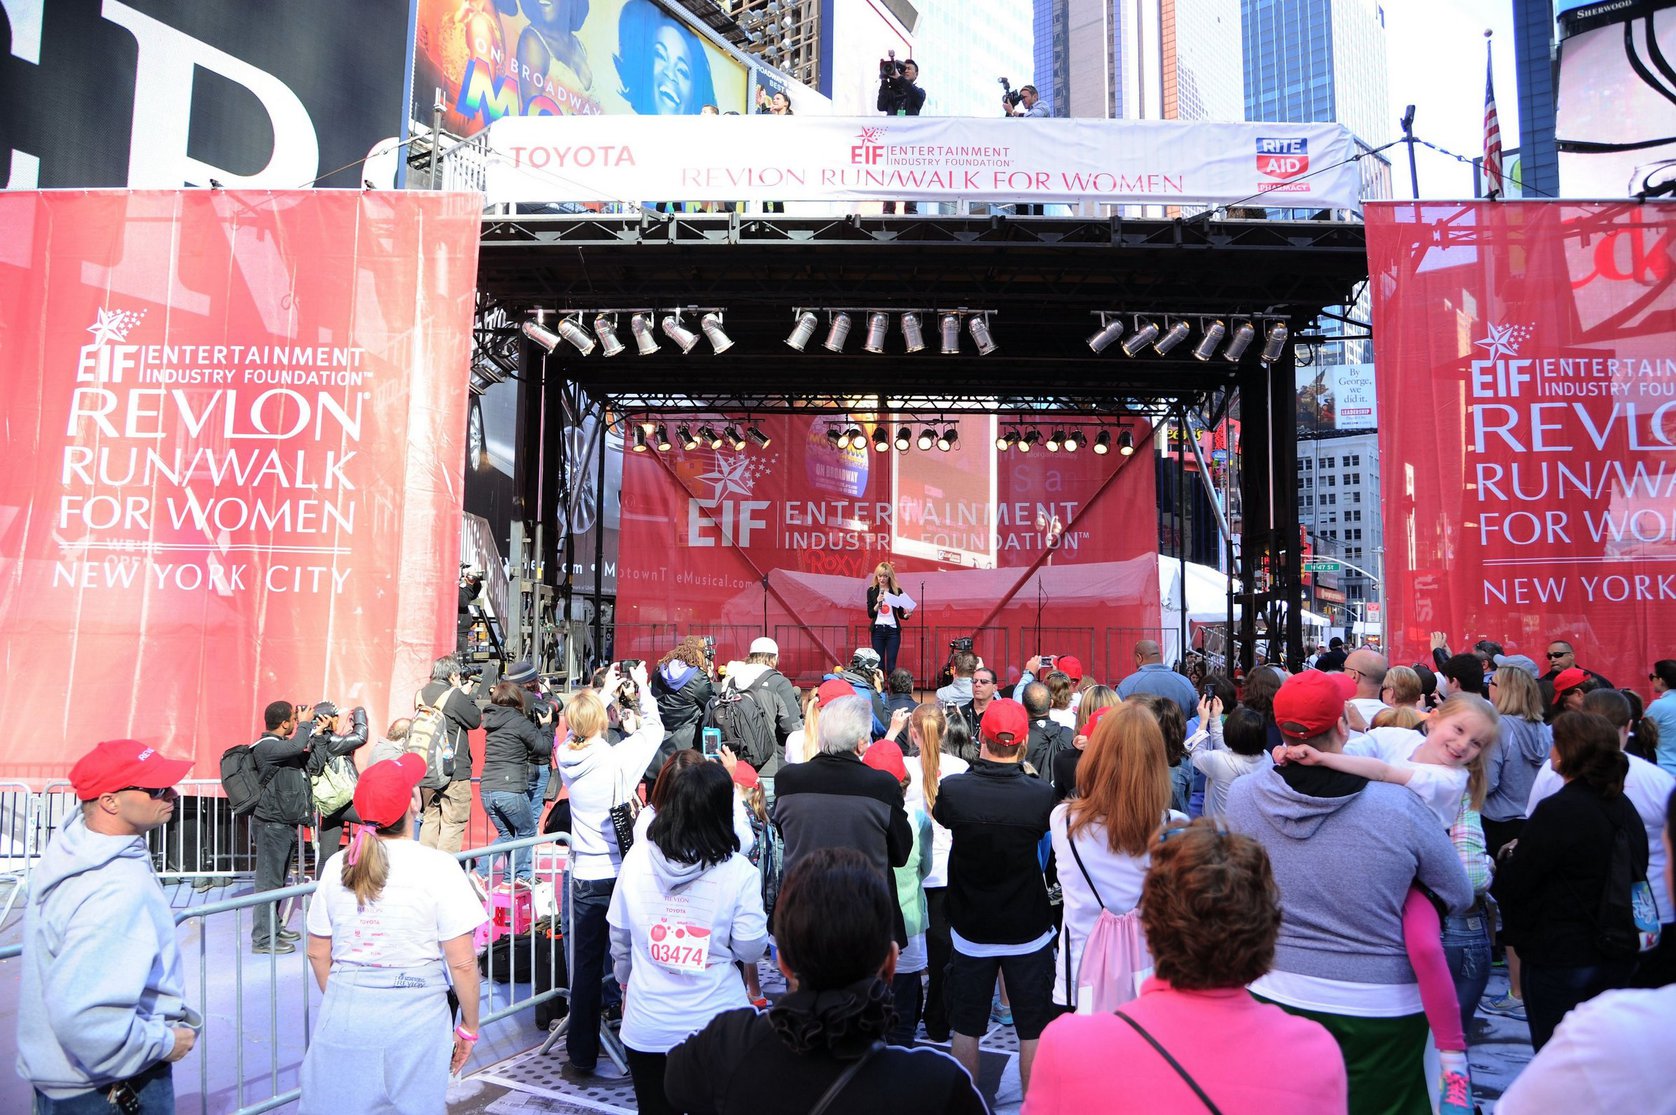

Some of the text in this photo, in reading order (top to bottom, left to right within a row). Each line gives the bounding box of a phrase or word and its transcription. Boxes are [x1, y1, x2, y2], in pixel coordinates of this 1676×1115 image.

[1576, 0, 1633, 19] SHERWOOD
[475, 38, 501, 64] ON
[510, 145, 636, 168] TOYOTA
[851, 145, 886, 165] EIF
[890, 146, 1011, 157] ENTERTAINMENT
[1262, 139, 1301, 153] RITE
[890, 158, 941, 166] INDUSTRY
[1266, 158, 1300, 173] AID
[682, 167, 1184, 193] REVLON RUN/WALK FOR WOMEN
[1260, 184, 1307, 192] PHARMACY
[77, 344, 142, 383] EIF
[146, 345, 365, 367] ENTERTAINMENT
[146, 368, 235, 384] INDUSTRY
[1350, 368, 1360, 378] By
[1471, 359, 1534, 398] EIF
[1344, 395, 1358, 403] did
[1545, 382, 1631, 397] INDUSTRY
[61, 446, 358, 490] RUN/WALK
[59, 495, 356, 535] FOR WOMEN
[688, 498, 771, 547] EIF
[785, 501, 1078, 527] ENTERTAINMENT
[1479, 508, 1676, 545] FOR WO
[52, 562, 353, 594] NEW YORK CITY
[1483, 573, 1676, 605] NEW YORK
[651, 943, 703, 966] 03474
